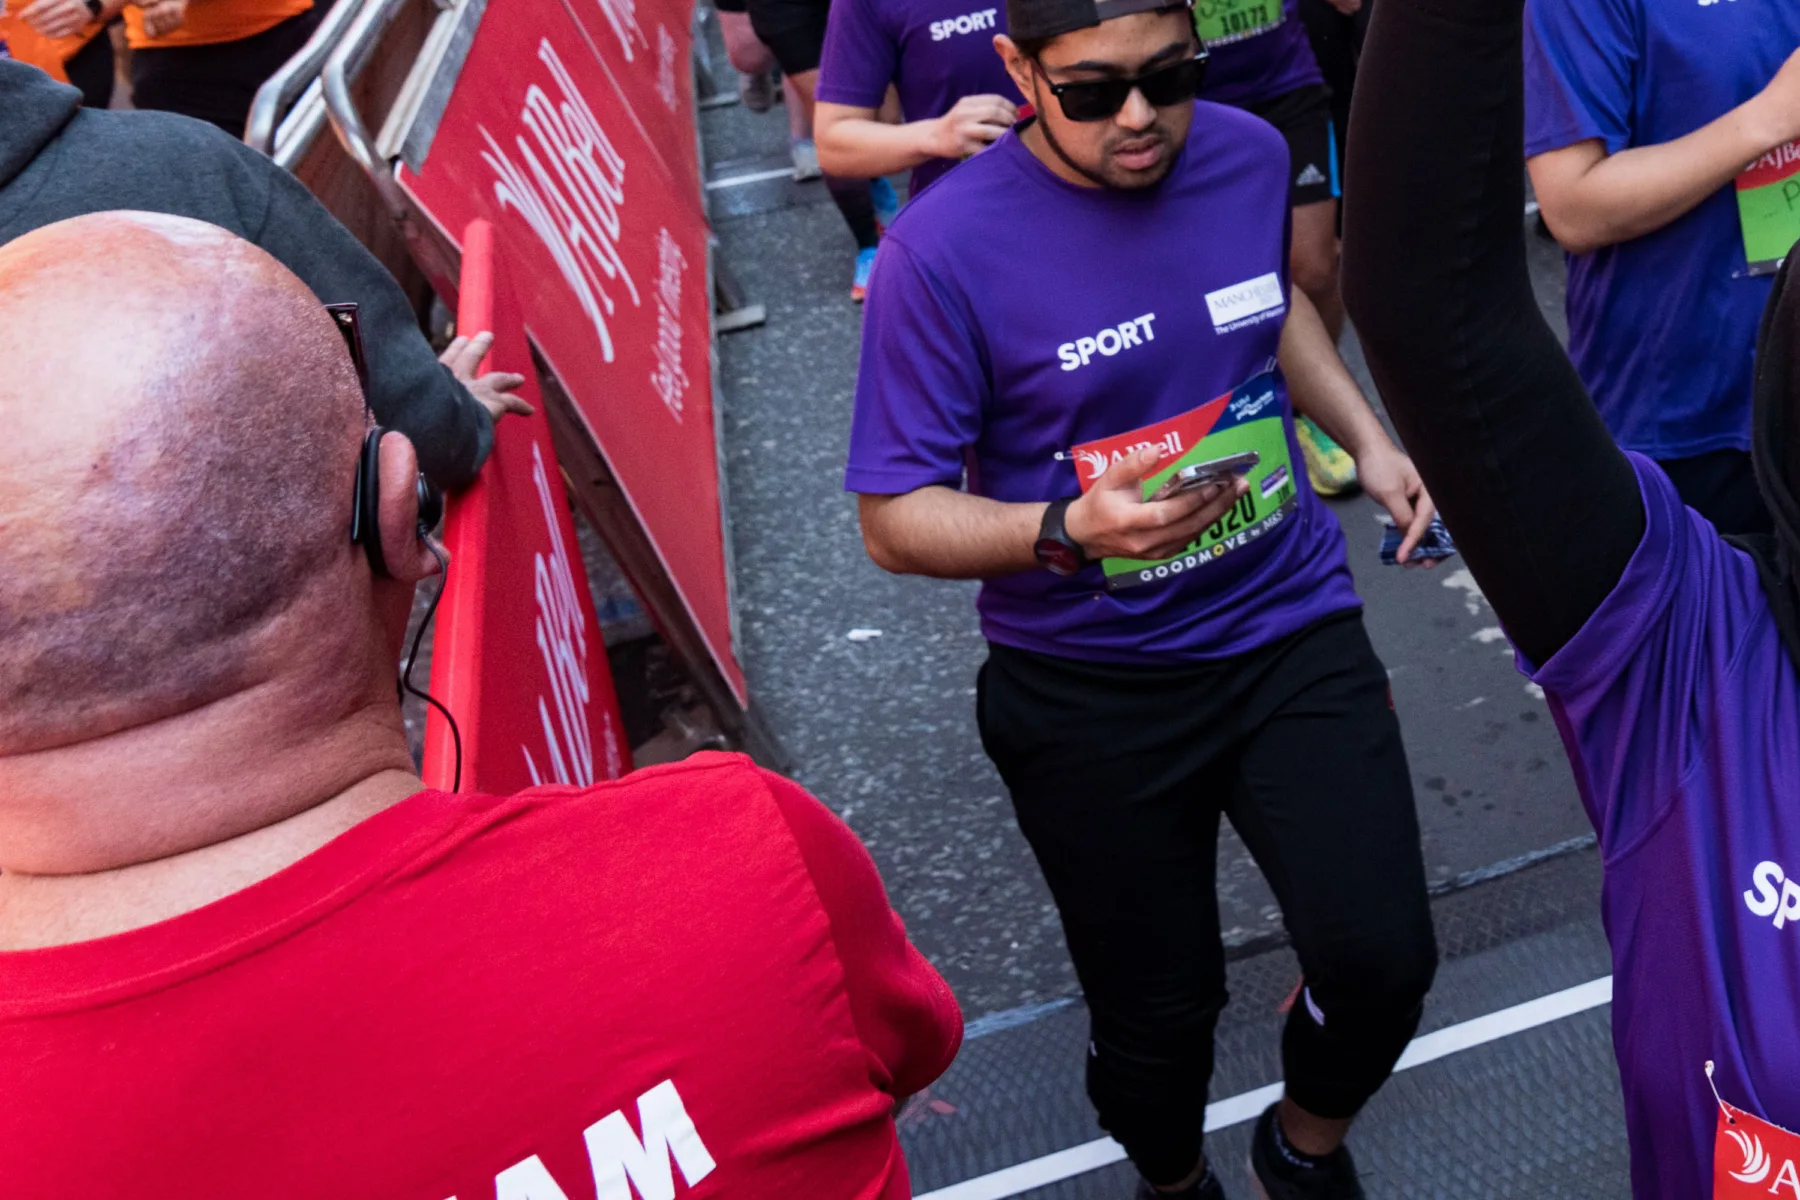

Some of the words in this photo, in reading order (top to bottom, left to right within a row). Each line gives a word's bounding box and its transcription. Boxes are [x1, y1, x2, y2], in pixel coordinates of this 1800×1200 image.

[930, 7, 998, 41] SPORT
[1057, 312, 1156, 372] SPORT
[1140, 530, 1248, 582] GOODMOVE
